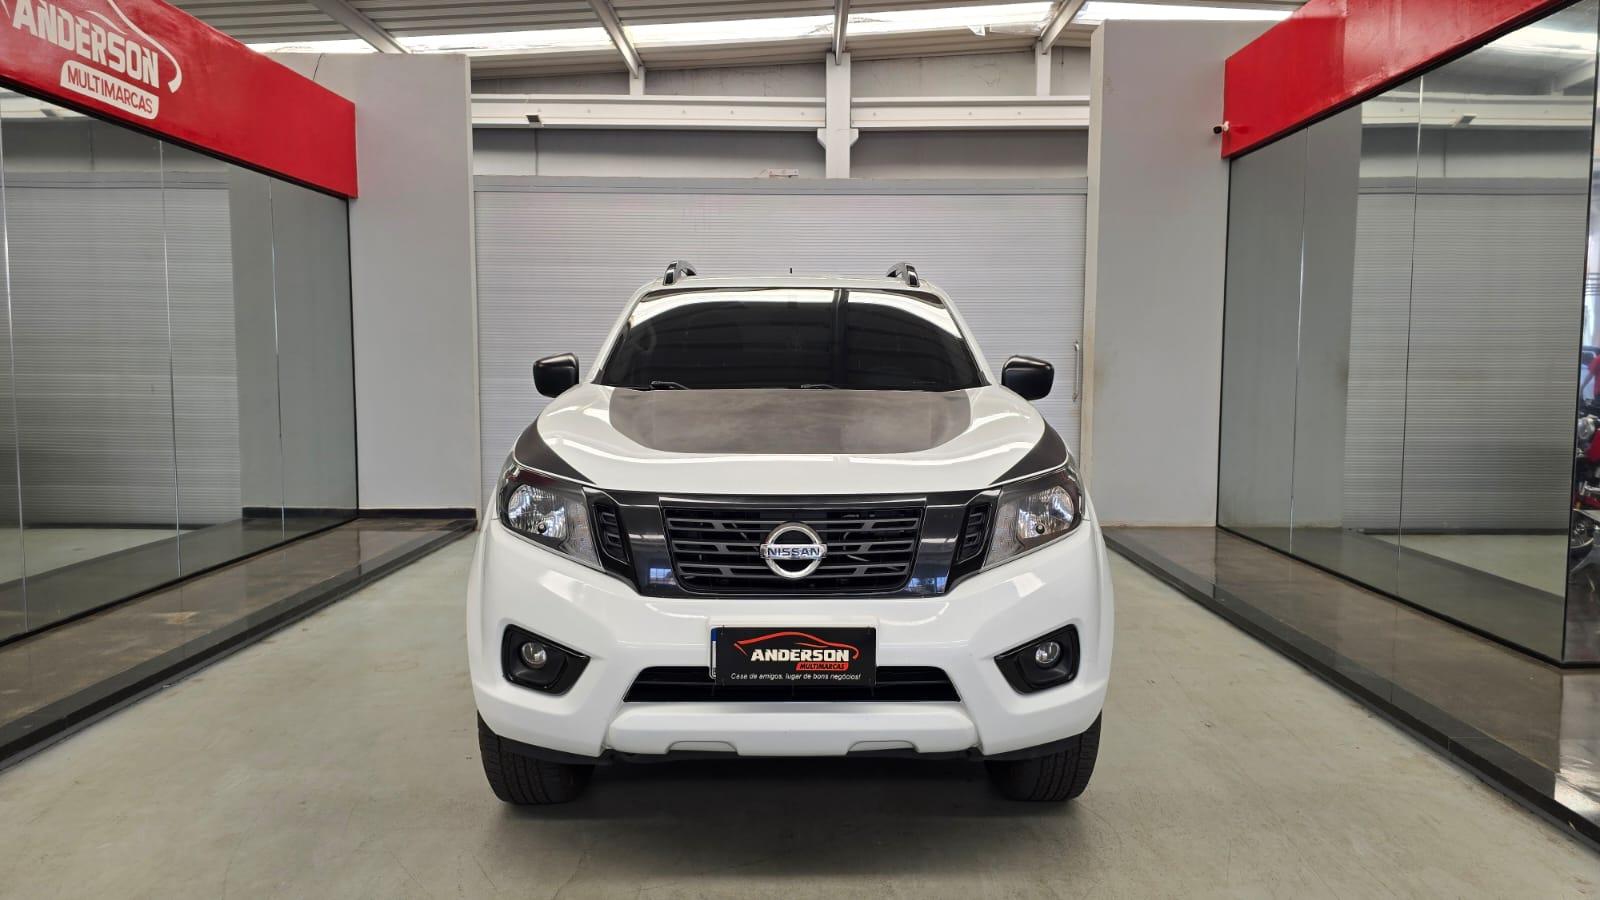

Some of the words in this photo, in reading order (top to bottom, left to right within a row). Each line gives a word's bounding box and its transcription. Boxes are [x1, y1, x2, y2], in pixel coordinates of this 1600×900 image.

[12, 0, 160, 89] ANDERSON
[67, 64, 153, 114] MULTIMARCAS
[767, 547, 820, 556] NISSAN
[751, 649, 850, 662] ANDERSON
